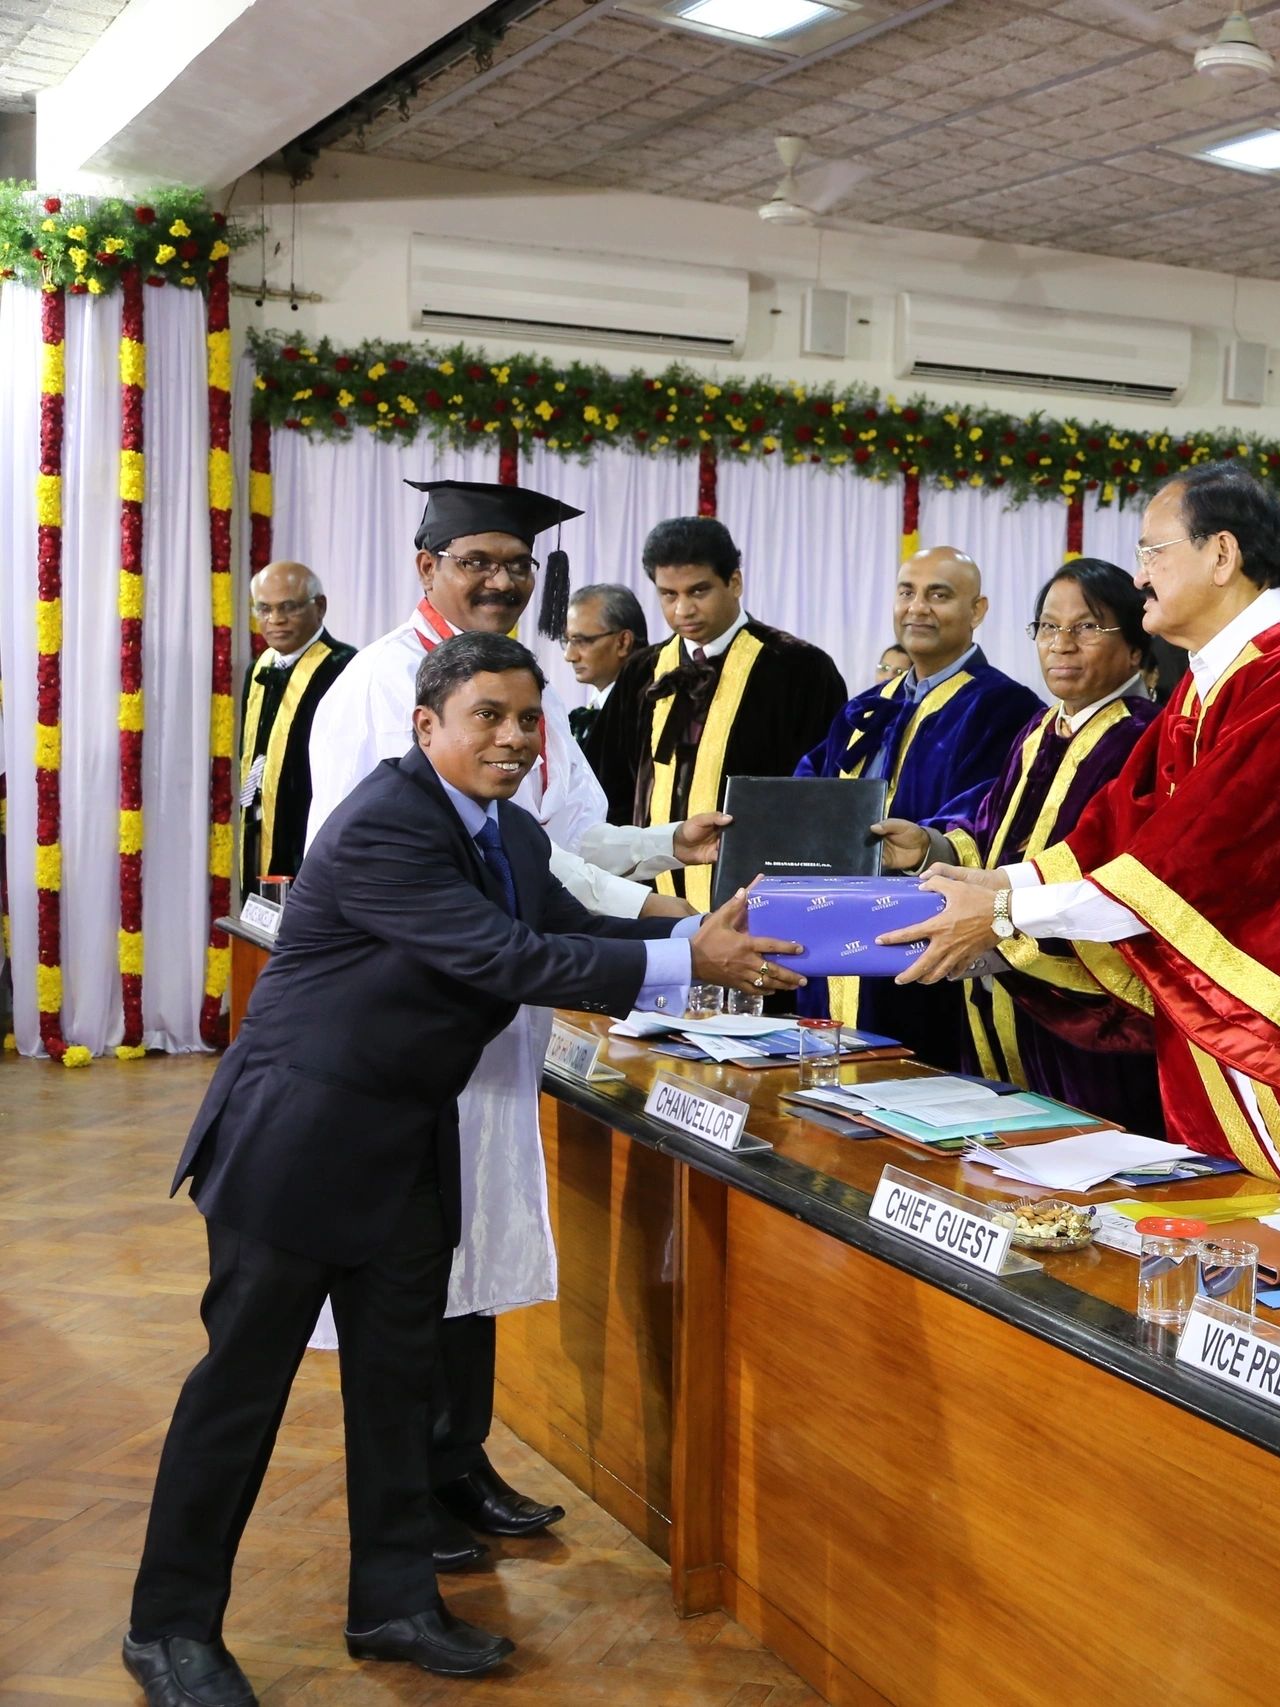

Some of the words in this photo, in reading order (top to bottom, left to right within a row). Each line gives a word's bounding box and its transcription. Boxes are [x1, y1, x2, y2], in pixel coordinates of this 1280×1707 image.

[811, 896, 827, 906] VIT
[876, 896, 891, 906] VIT
[845, 940, 860, 951] VIT
[910, 941, 925, 950] VIT
[656, 1086, 734, 1141] CHANCELLOR
[885, 1188, 936, 1234] CHIEF
[935, 1210, 999, 1263] GUEST
[1201, 1323, 1250, 1378] VICE
